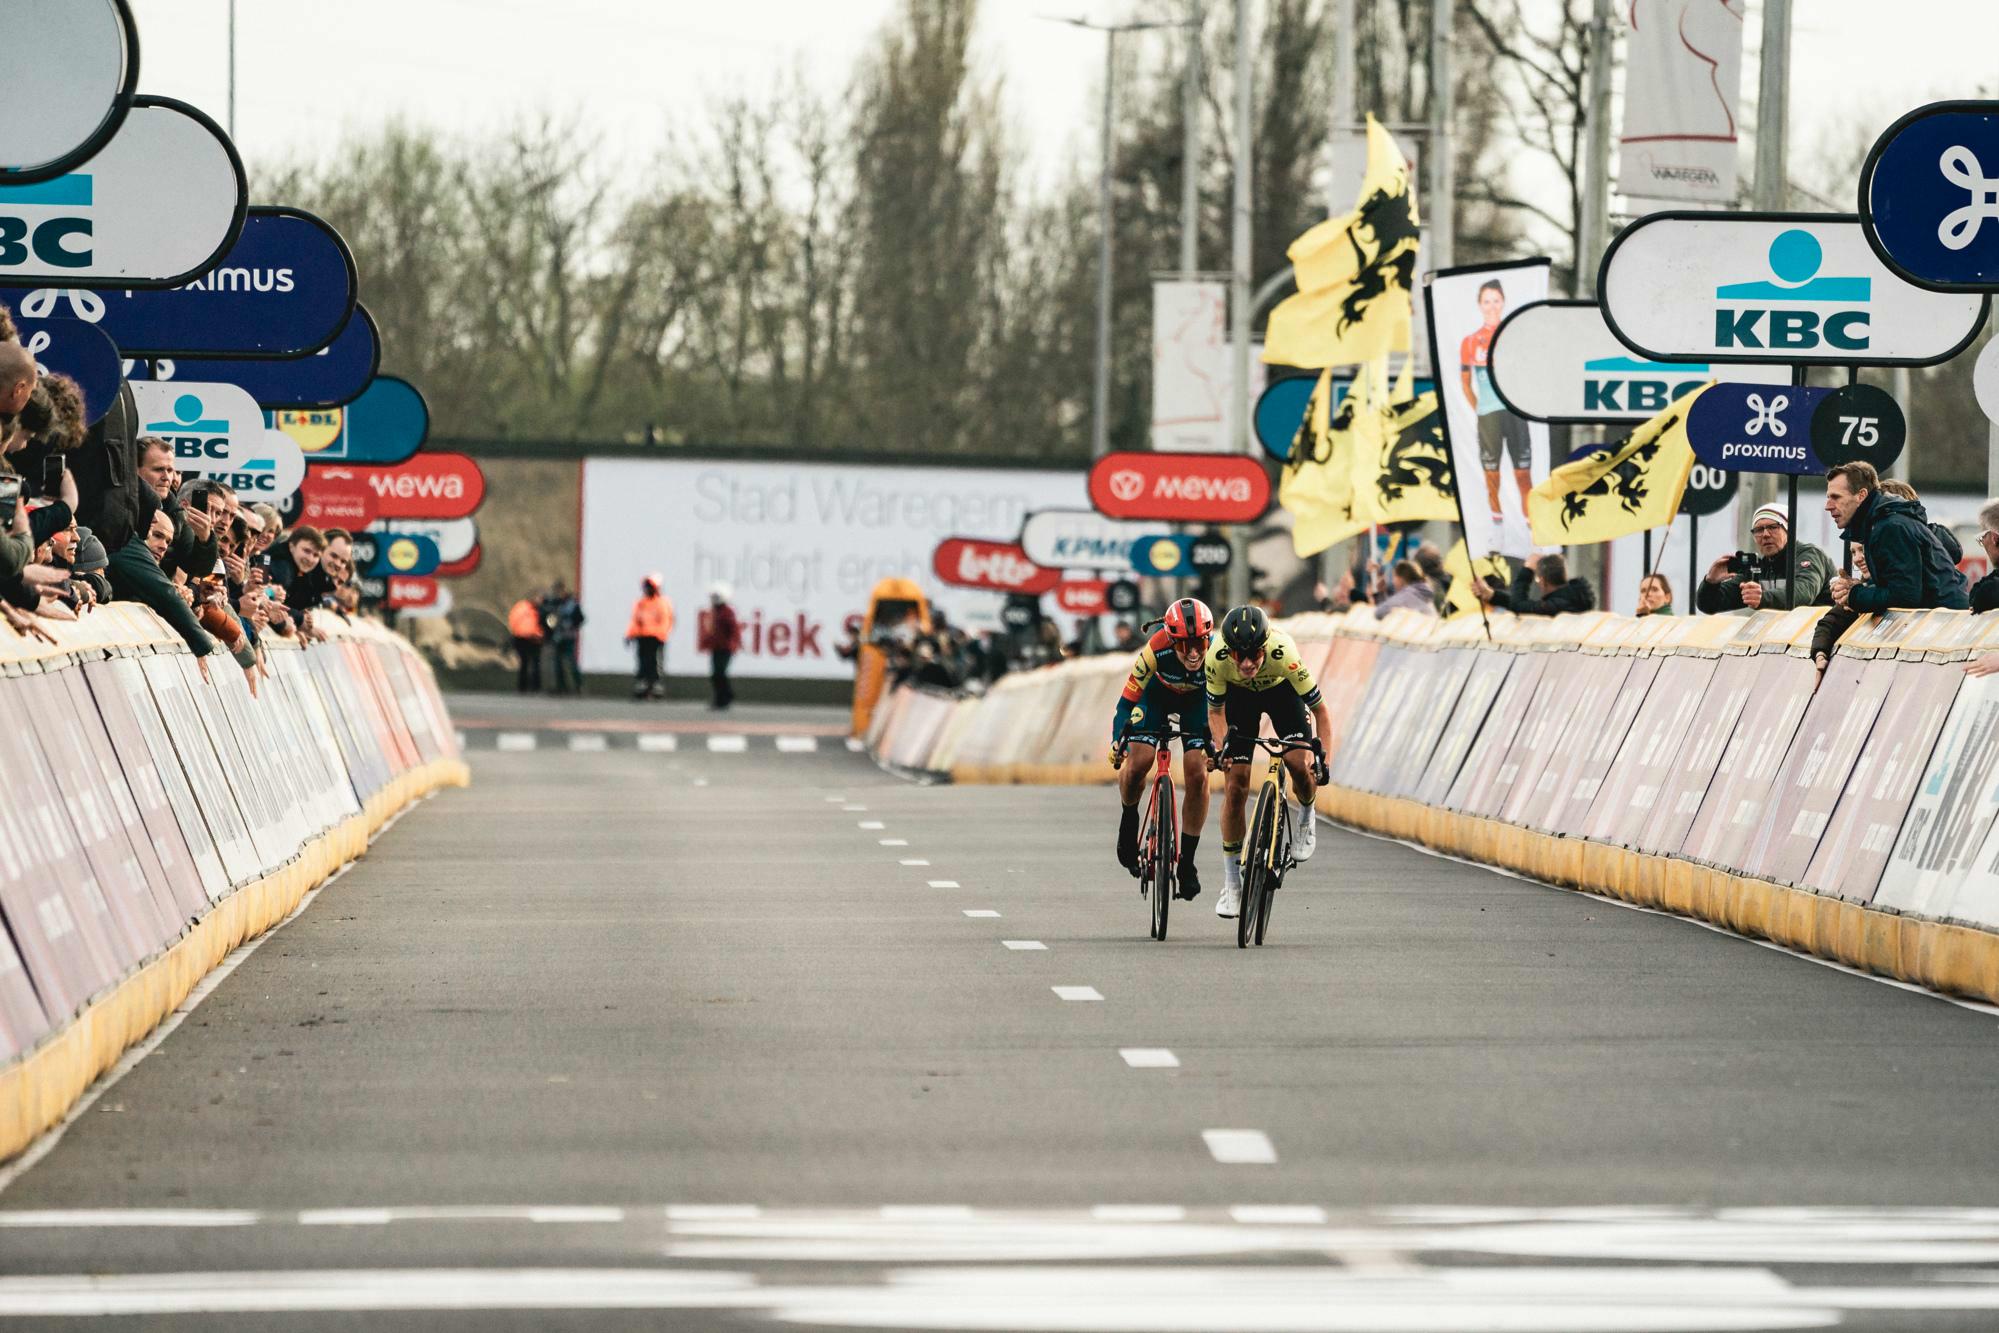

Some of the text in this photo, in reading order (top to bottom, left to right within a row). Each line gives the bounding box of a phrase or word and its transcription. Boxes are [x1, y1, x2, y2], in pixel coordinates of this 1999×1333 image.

[1714, 308, 1871, 350] KBC
[1838, 416, 1879, 448] 75
[1722, 443, 1807, 460] proximus
[1153, 475, 1251, 501] mewa
[1689, 463, 1727, 490] 00
[693, 468, 1031, 534] Stad Waregem
[1192, 545, 1228, 564] 200
